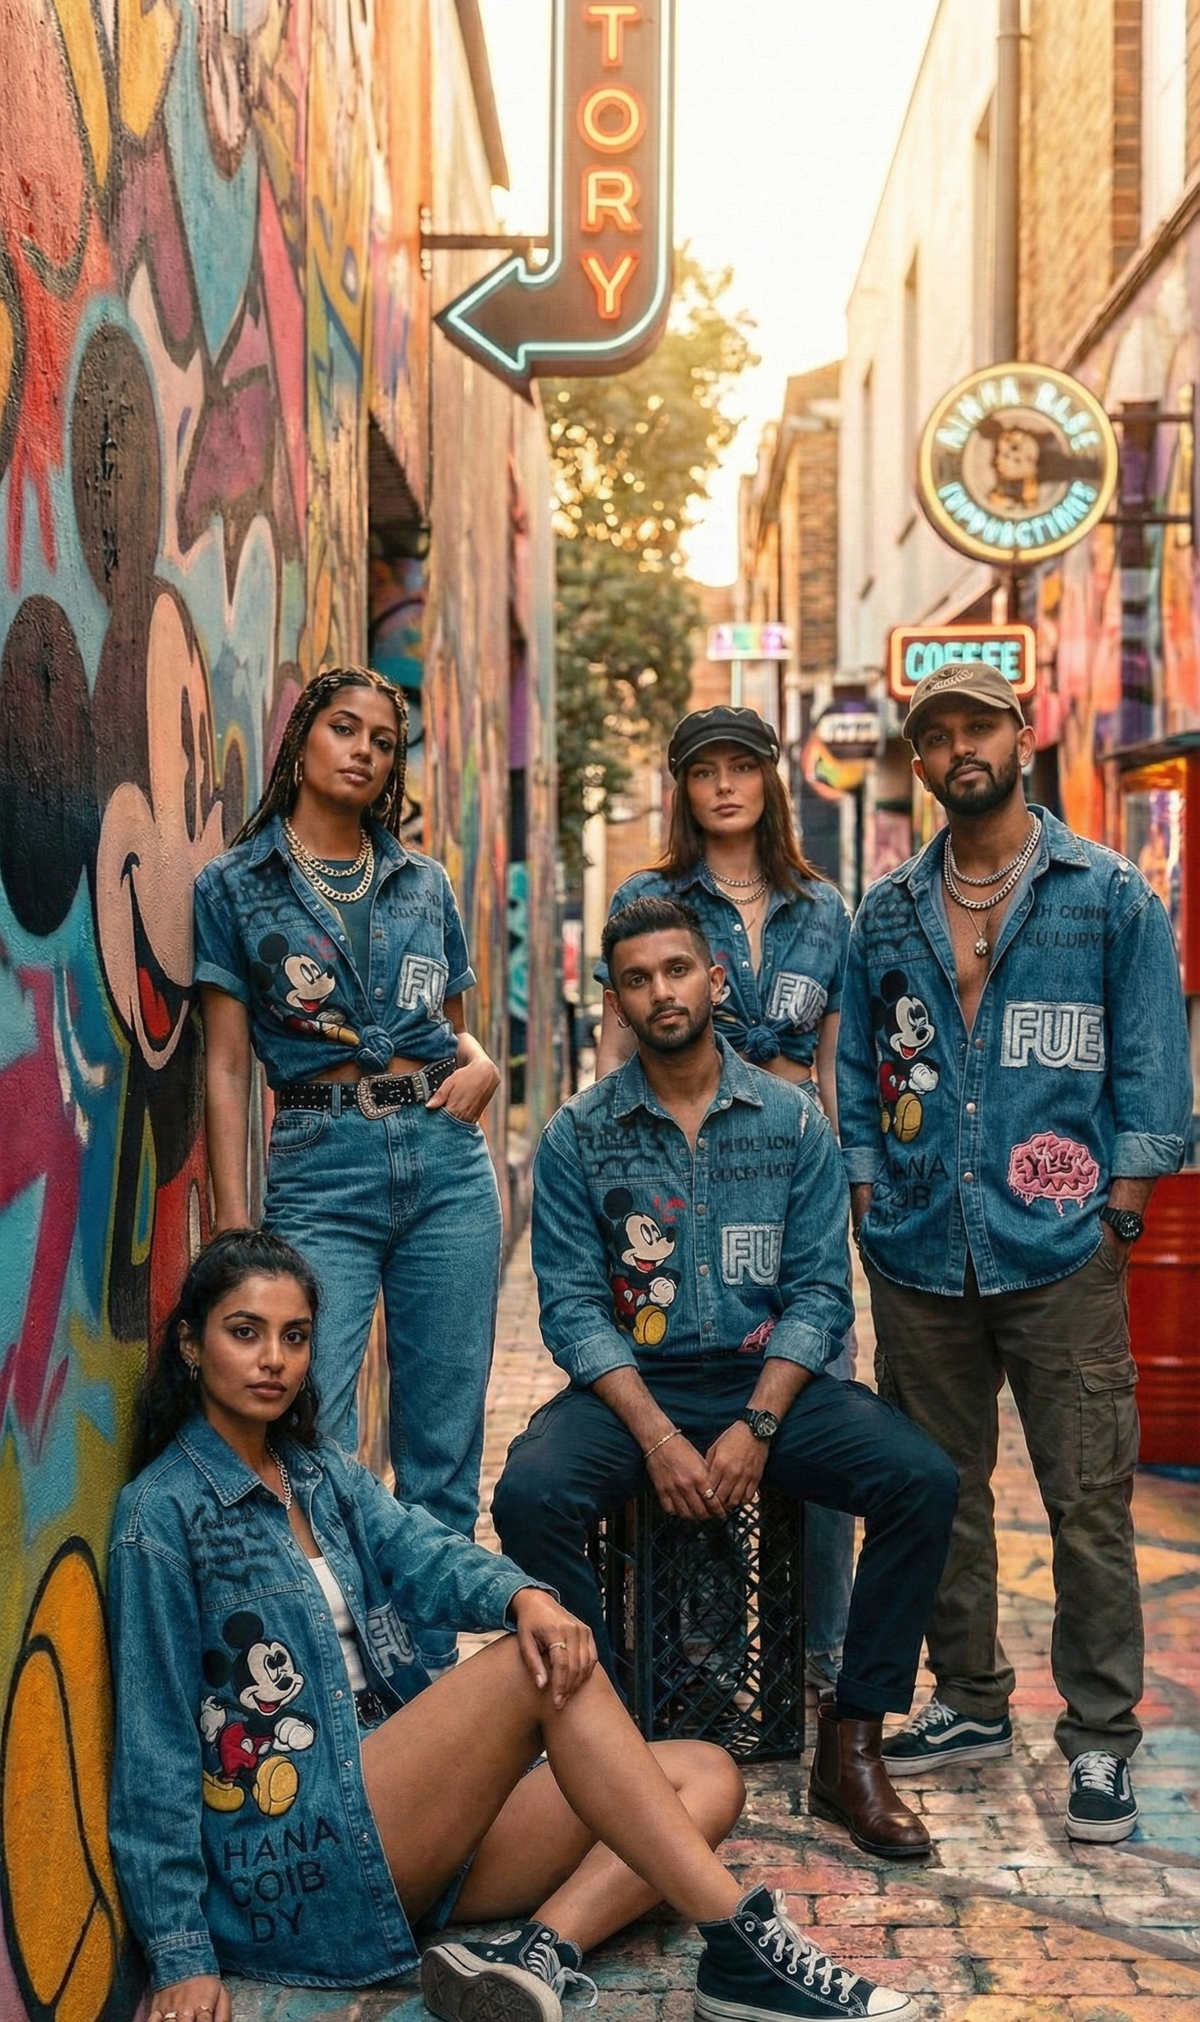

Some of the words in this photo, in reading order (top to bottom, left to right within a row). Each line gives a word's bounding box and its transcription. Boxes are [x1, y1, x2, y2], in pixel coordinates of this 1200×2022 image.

[577, 2, 646, 318] TORY
[905, 641, 1022, 681] COFFEE
[223, 1815, 341, 1872] HANA
[229, 1860, 326, 1909] COIB
[249, 1902, 304, 1944] DY
